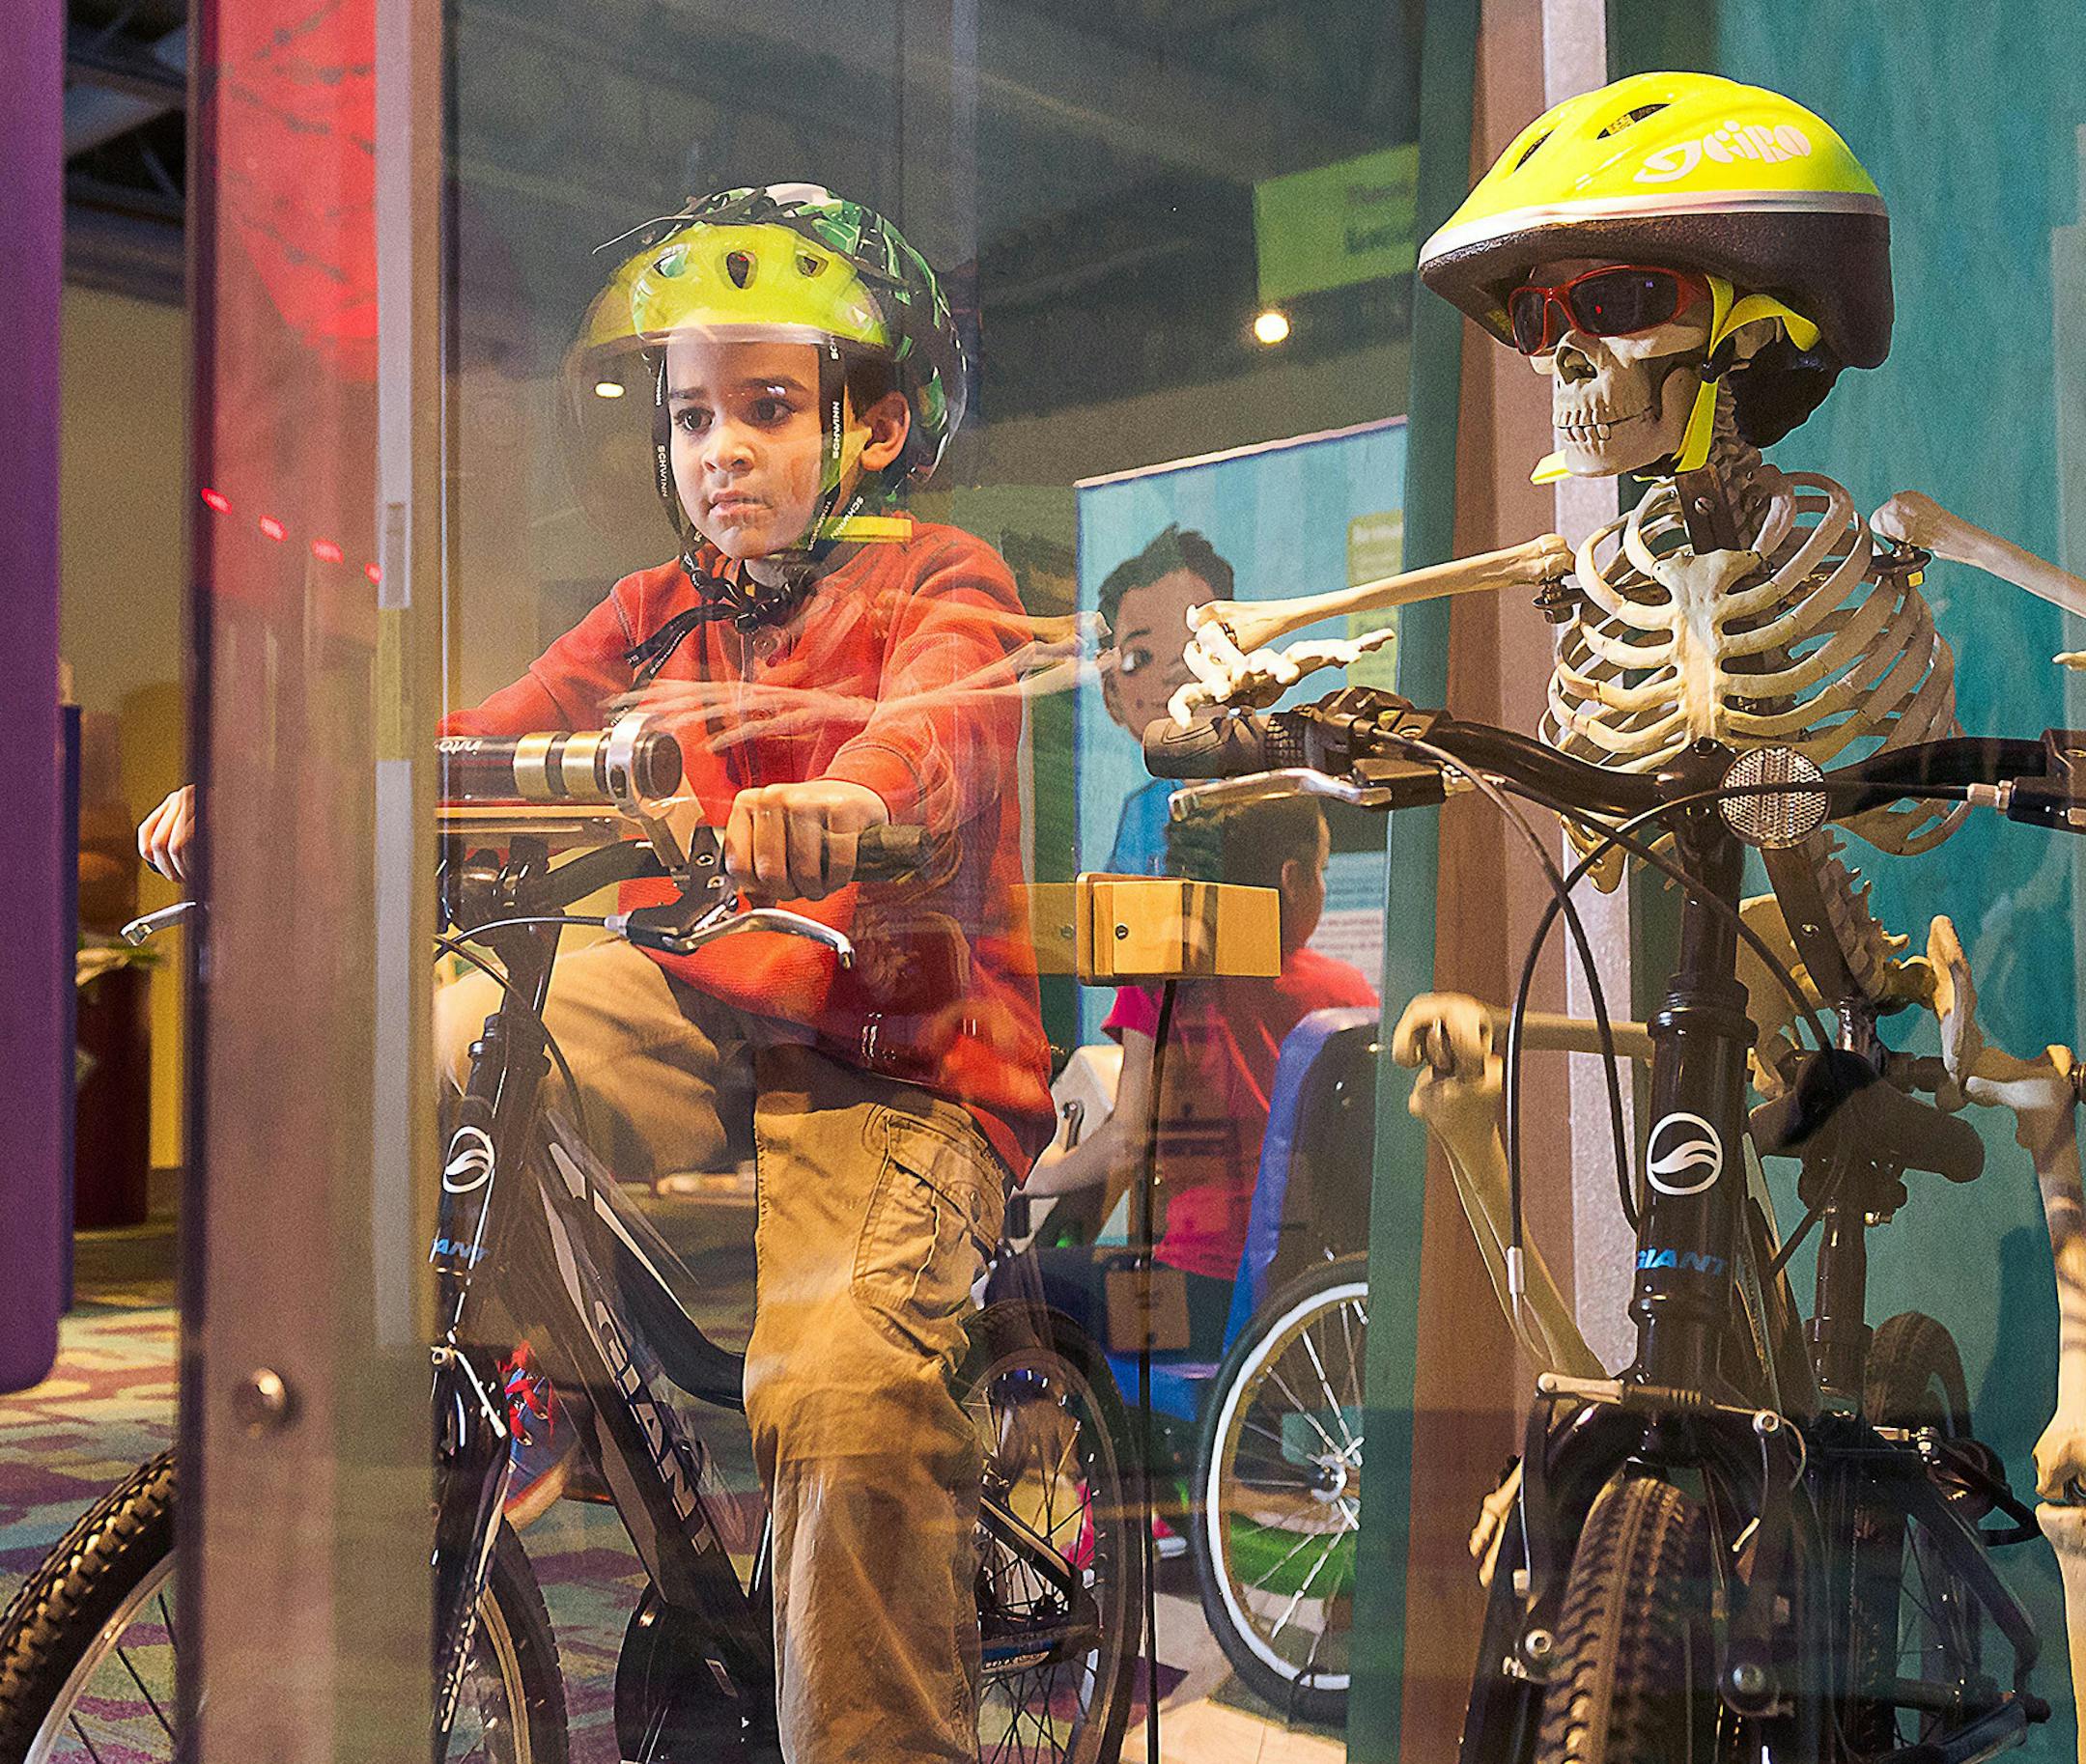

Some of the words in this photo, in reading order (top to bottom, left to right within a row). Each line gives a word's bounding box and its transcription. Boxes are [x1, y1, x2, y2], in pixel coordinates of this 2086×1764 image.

[657, 444, 668, 497] SCHWINN
[830, 495, 863, 539] SCHWINN
[594, 1301, 720, 1555] GIANT
